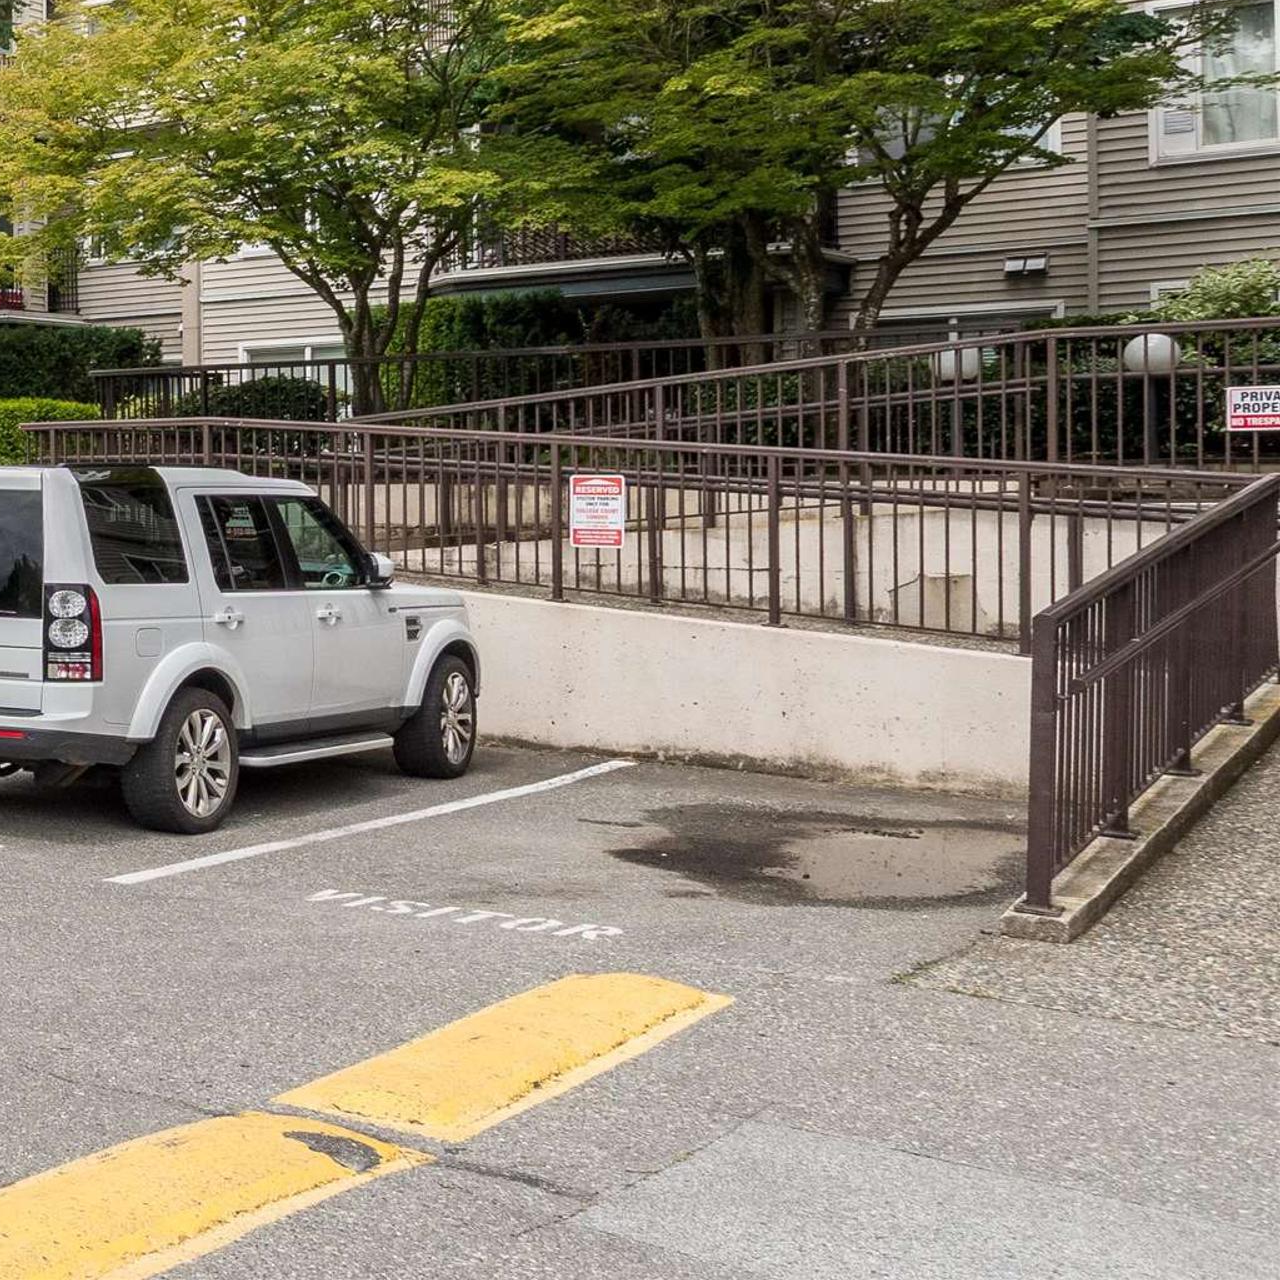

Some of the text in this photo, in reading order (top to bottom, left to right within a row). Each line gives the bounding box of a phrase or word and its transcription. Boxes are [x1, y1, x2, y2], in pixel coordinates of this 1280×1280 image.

[1241, 391, 1280, 401] PRIVA
[1233, 402, 1279, 413] PROPE
[575, 486, 620, 494] RESERVED
[304, 888, 624, 940] VISITOR
